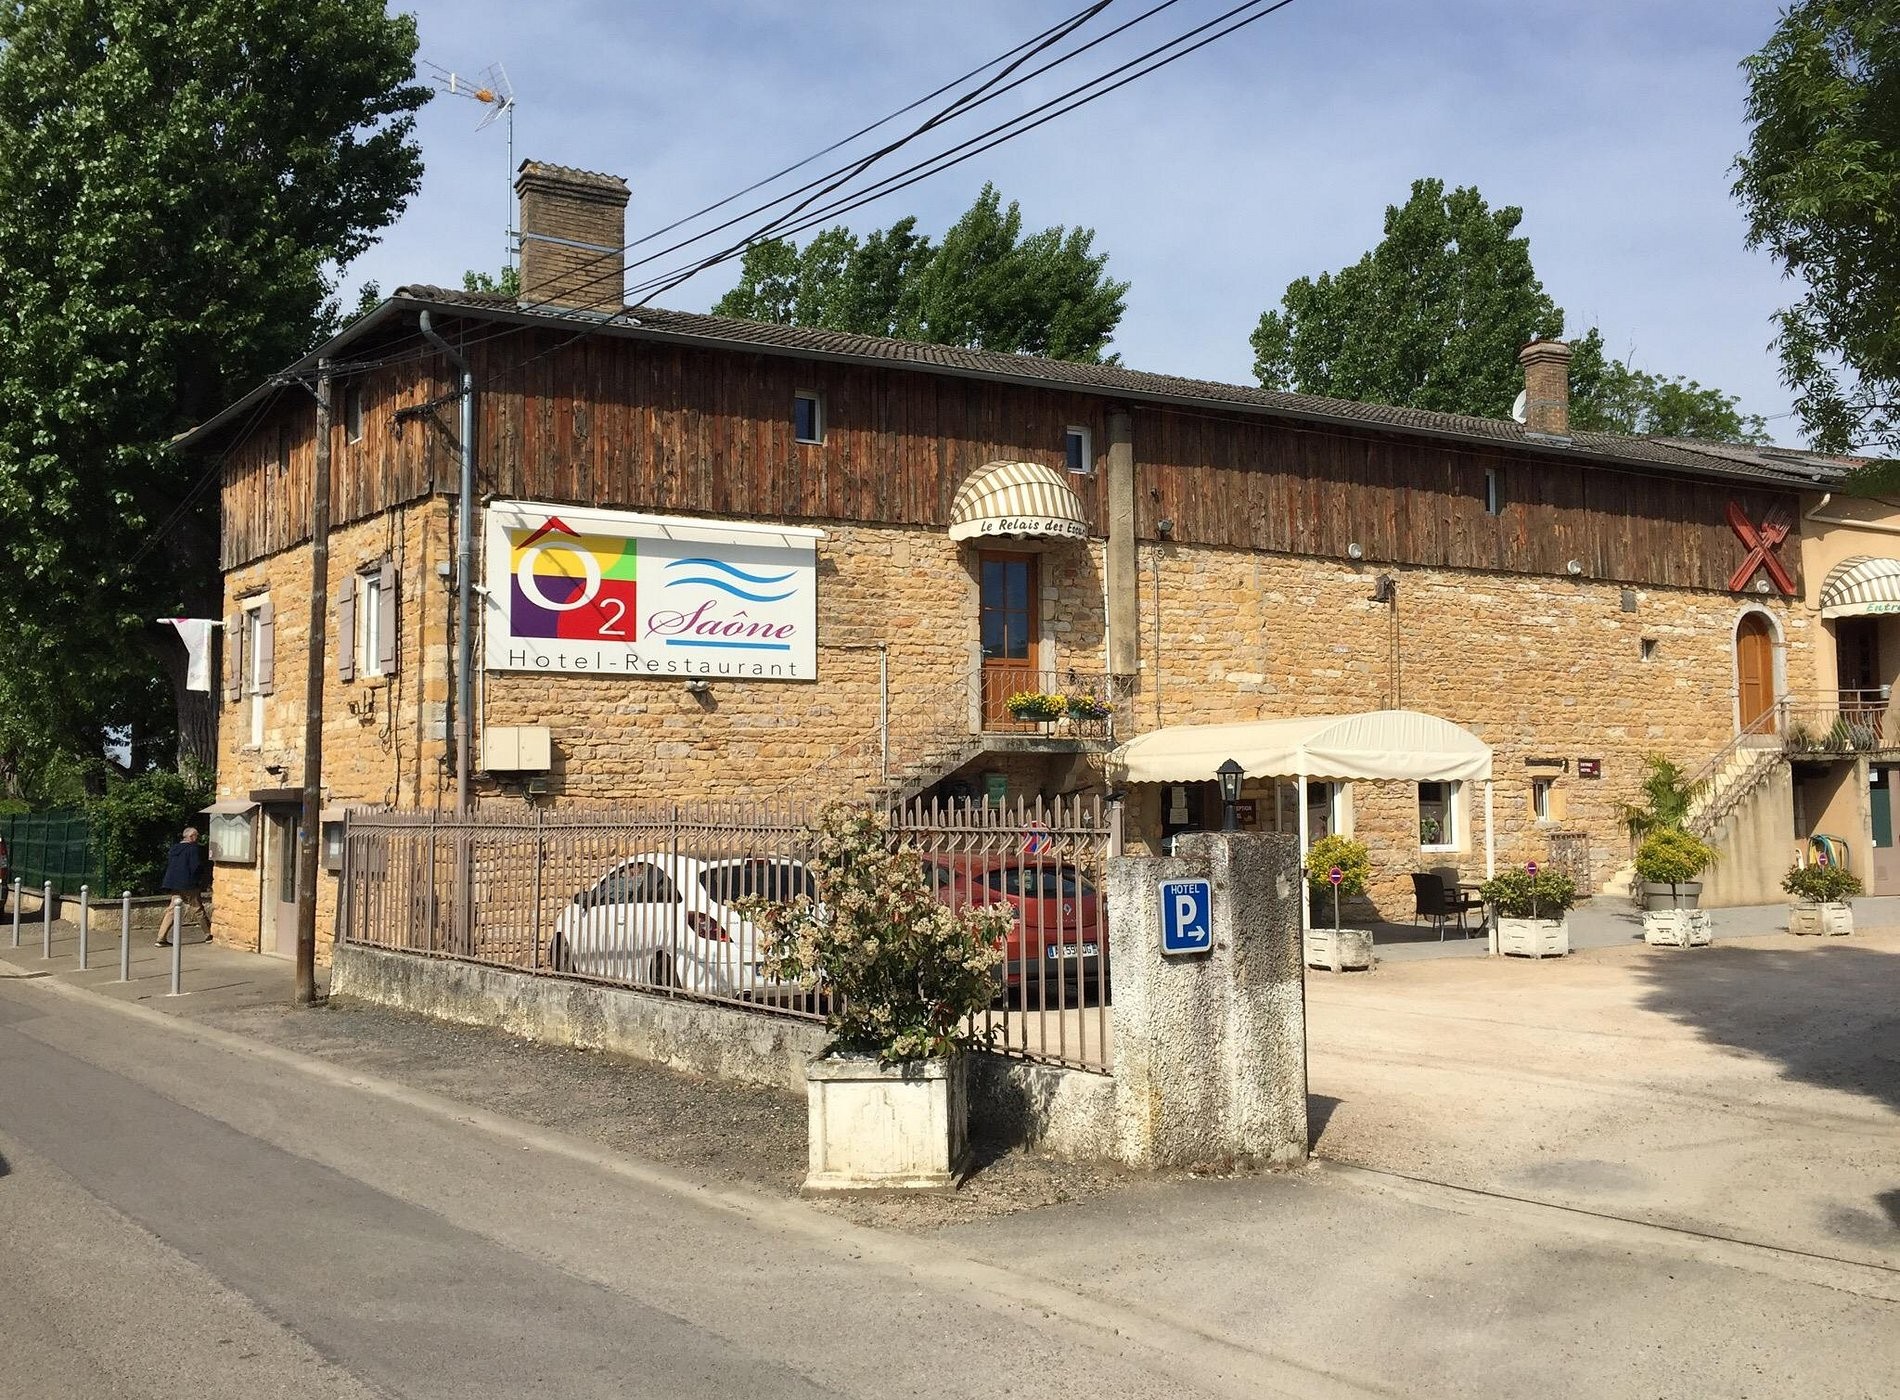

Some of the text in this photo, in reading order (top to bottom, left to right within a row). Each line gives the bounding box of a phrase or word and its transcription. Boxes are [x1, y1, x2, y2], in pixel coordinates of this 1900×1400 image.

[981, 520, 993, 532] Le
[999, 518, 1040, 531] Relais
[1045, 519, 1063, 532] des
[645, 599, 798, 640] Saône
[508, 648, 798, 677] Hotel-Restaurant
[1171, 883, 1200, 895] HOTEL
[1175, 894, 1197, 938] P
